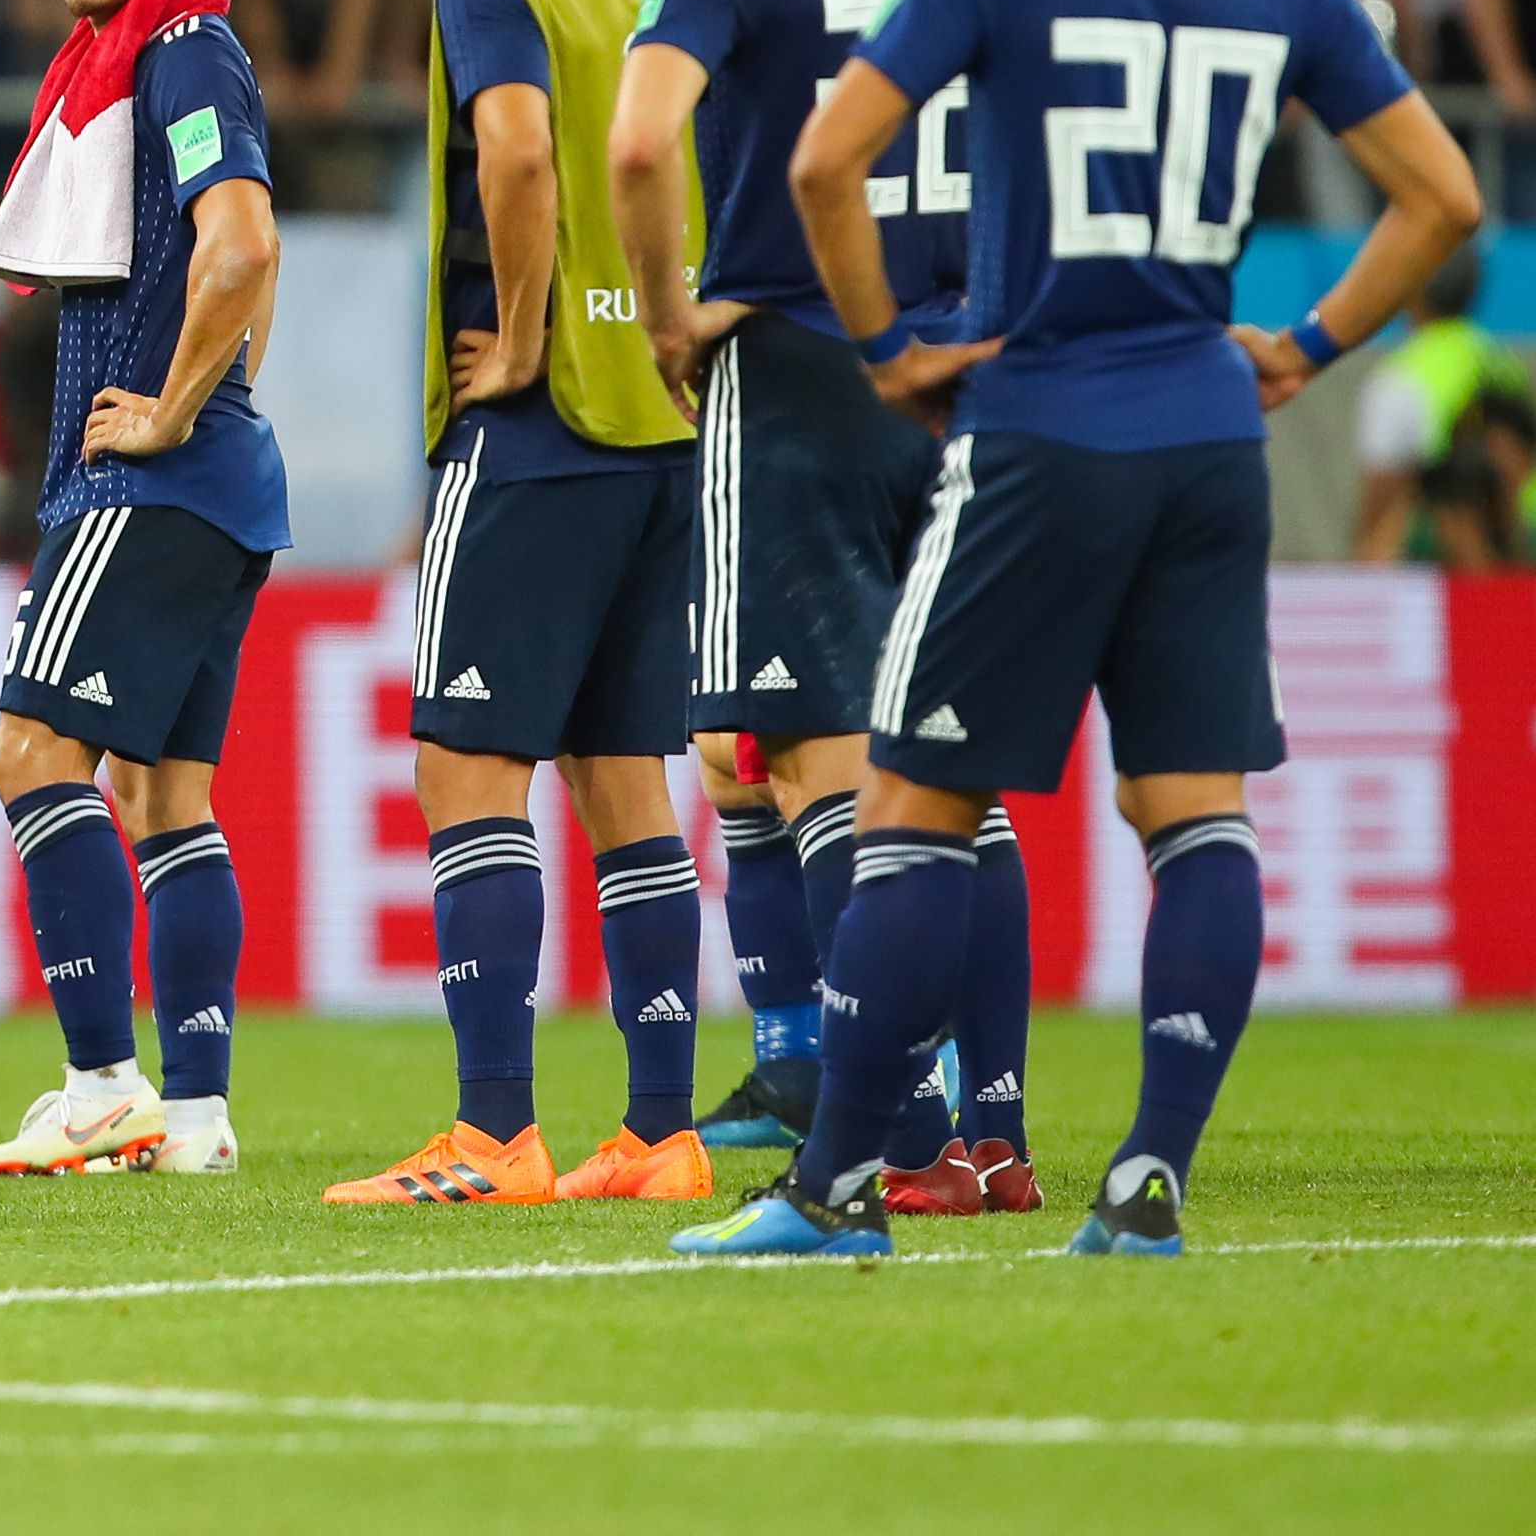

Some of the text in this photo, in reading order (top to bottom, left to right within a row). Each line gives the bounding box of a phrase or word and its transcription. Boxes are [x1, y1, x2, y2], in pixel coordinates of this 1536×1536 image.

[1045, 17, 1290, 264] 20
[69, 686, 114, 706] adidas
[42, 956, 96, 985] PAN
[437, 959, 480, 989] PAN
[637, 1010, 691, 1023] adidas
[977, 1088, 1023, 1103] adidas
